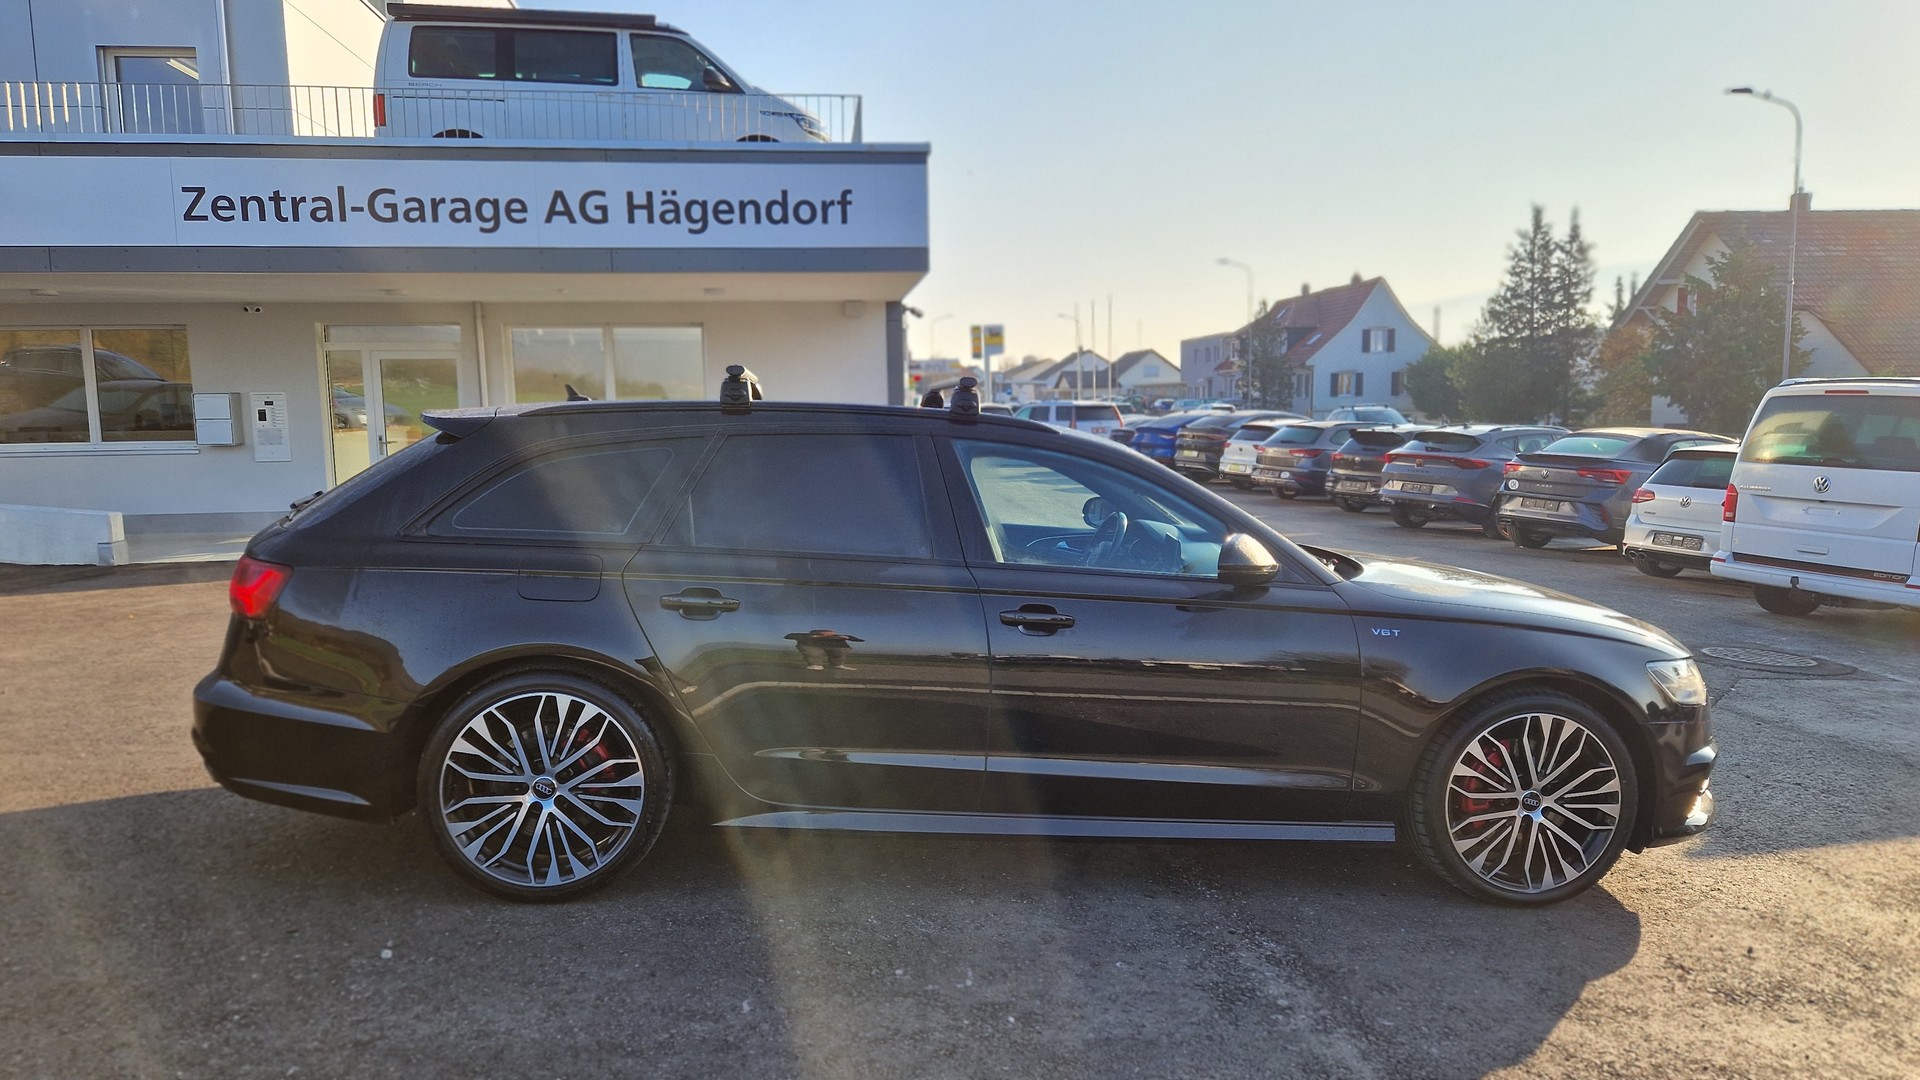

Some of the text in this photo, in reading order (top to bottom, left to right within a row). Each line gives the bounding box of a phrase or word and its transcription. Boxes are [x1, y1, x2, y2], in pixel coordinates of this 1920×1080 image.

[181, 185, 853, 235] Zentral-Garage AG Hägendorf
